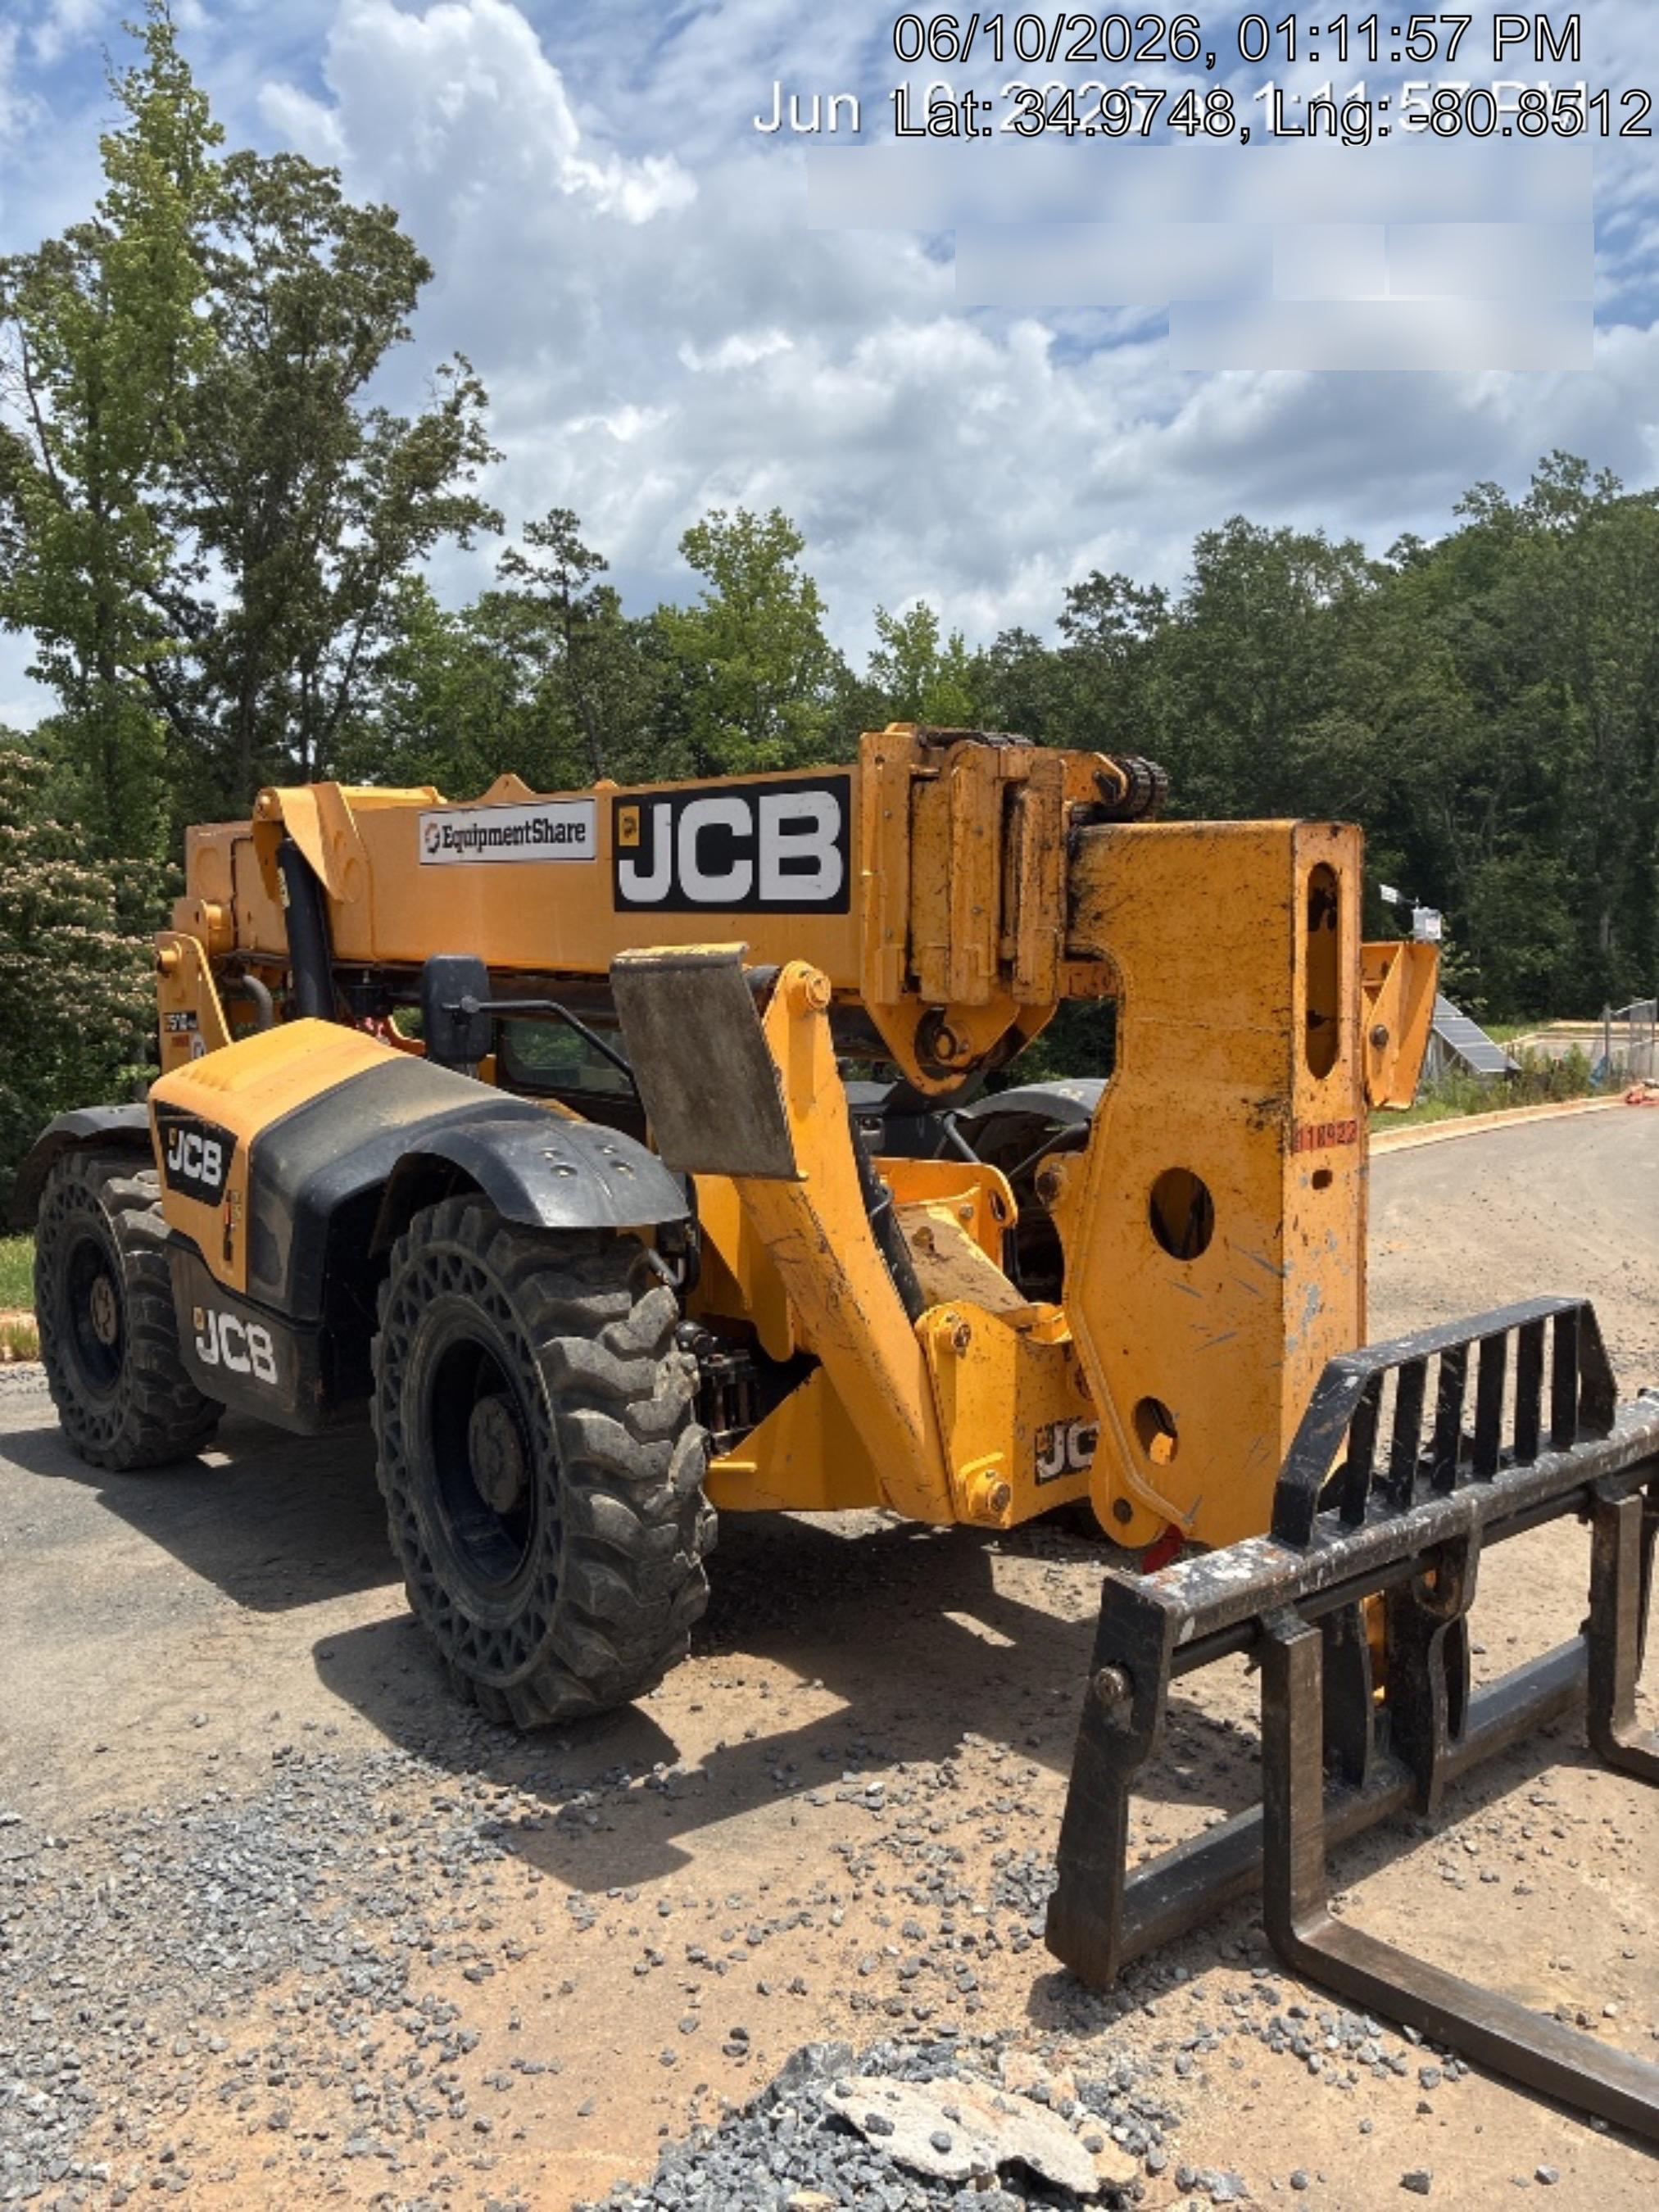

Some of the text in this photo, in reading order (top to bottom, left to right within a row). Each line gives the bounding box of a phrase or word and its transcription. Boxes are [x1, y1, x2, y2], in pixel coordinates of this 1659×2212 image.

[442, 818, 587, 854] EquipmentShare
[619, 791, 844, 903] JCB
[168, 1130, 222, 1186] JCB
[195, 1309, 278, 1385] JCB
[1036, 1421, 1100, 1479] JC
